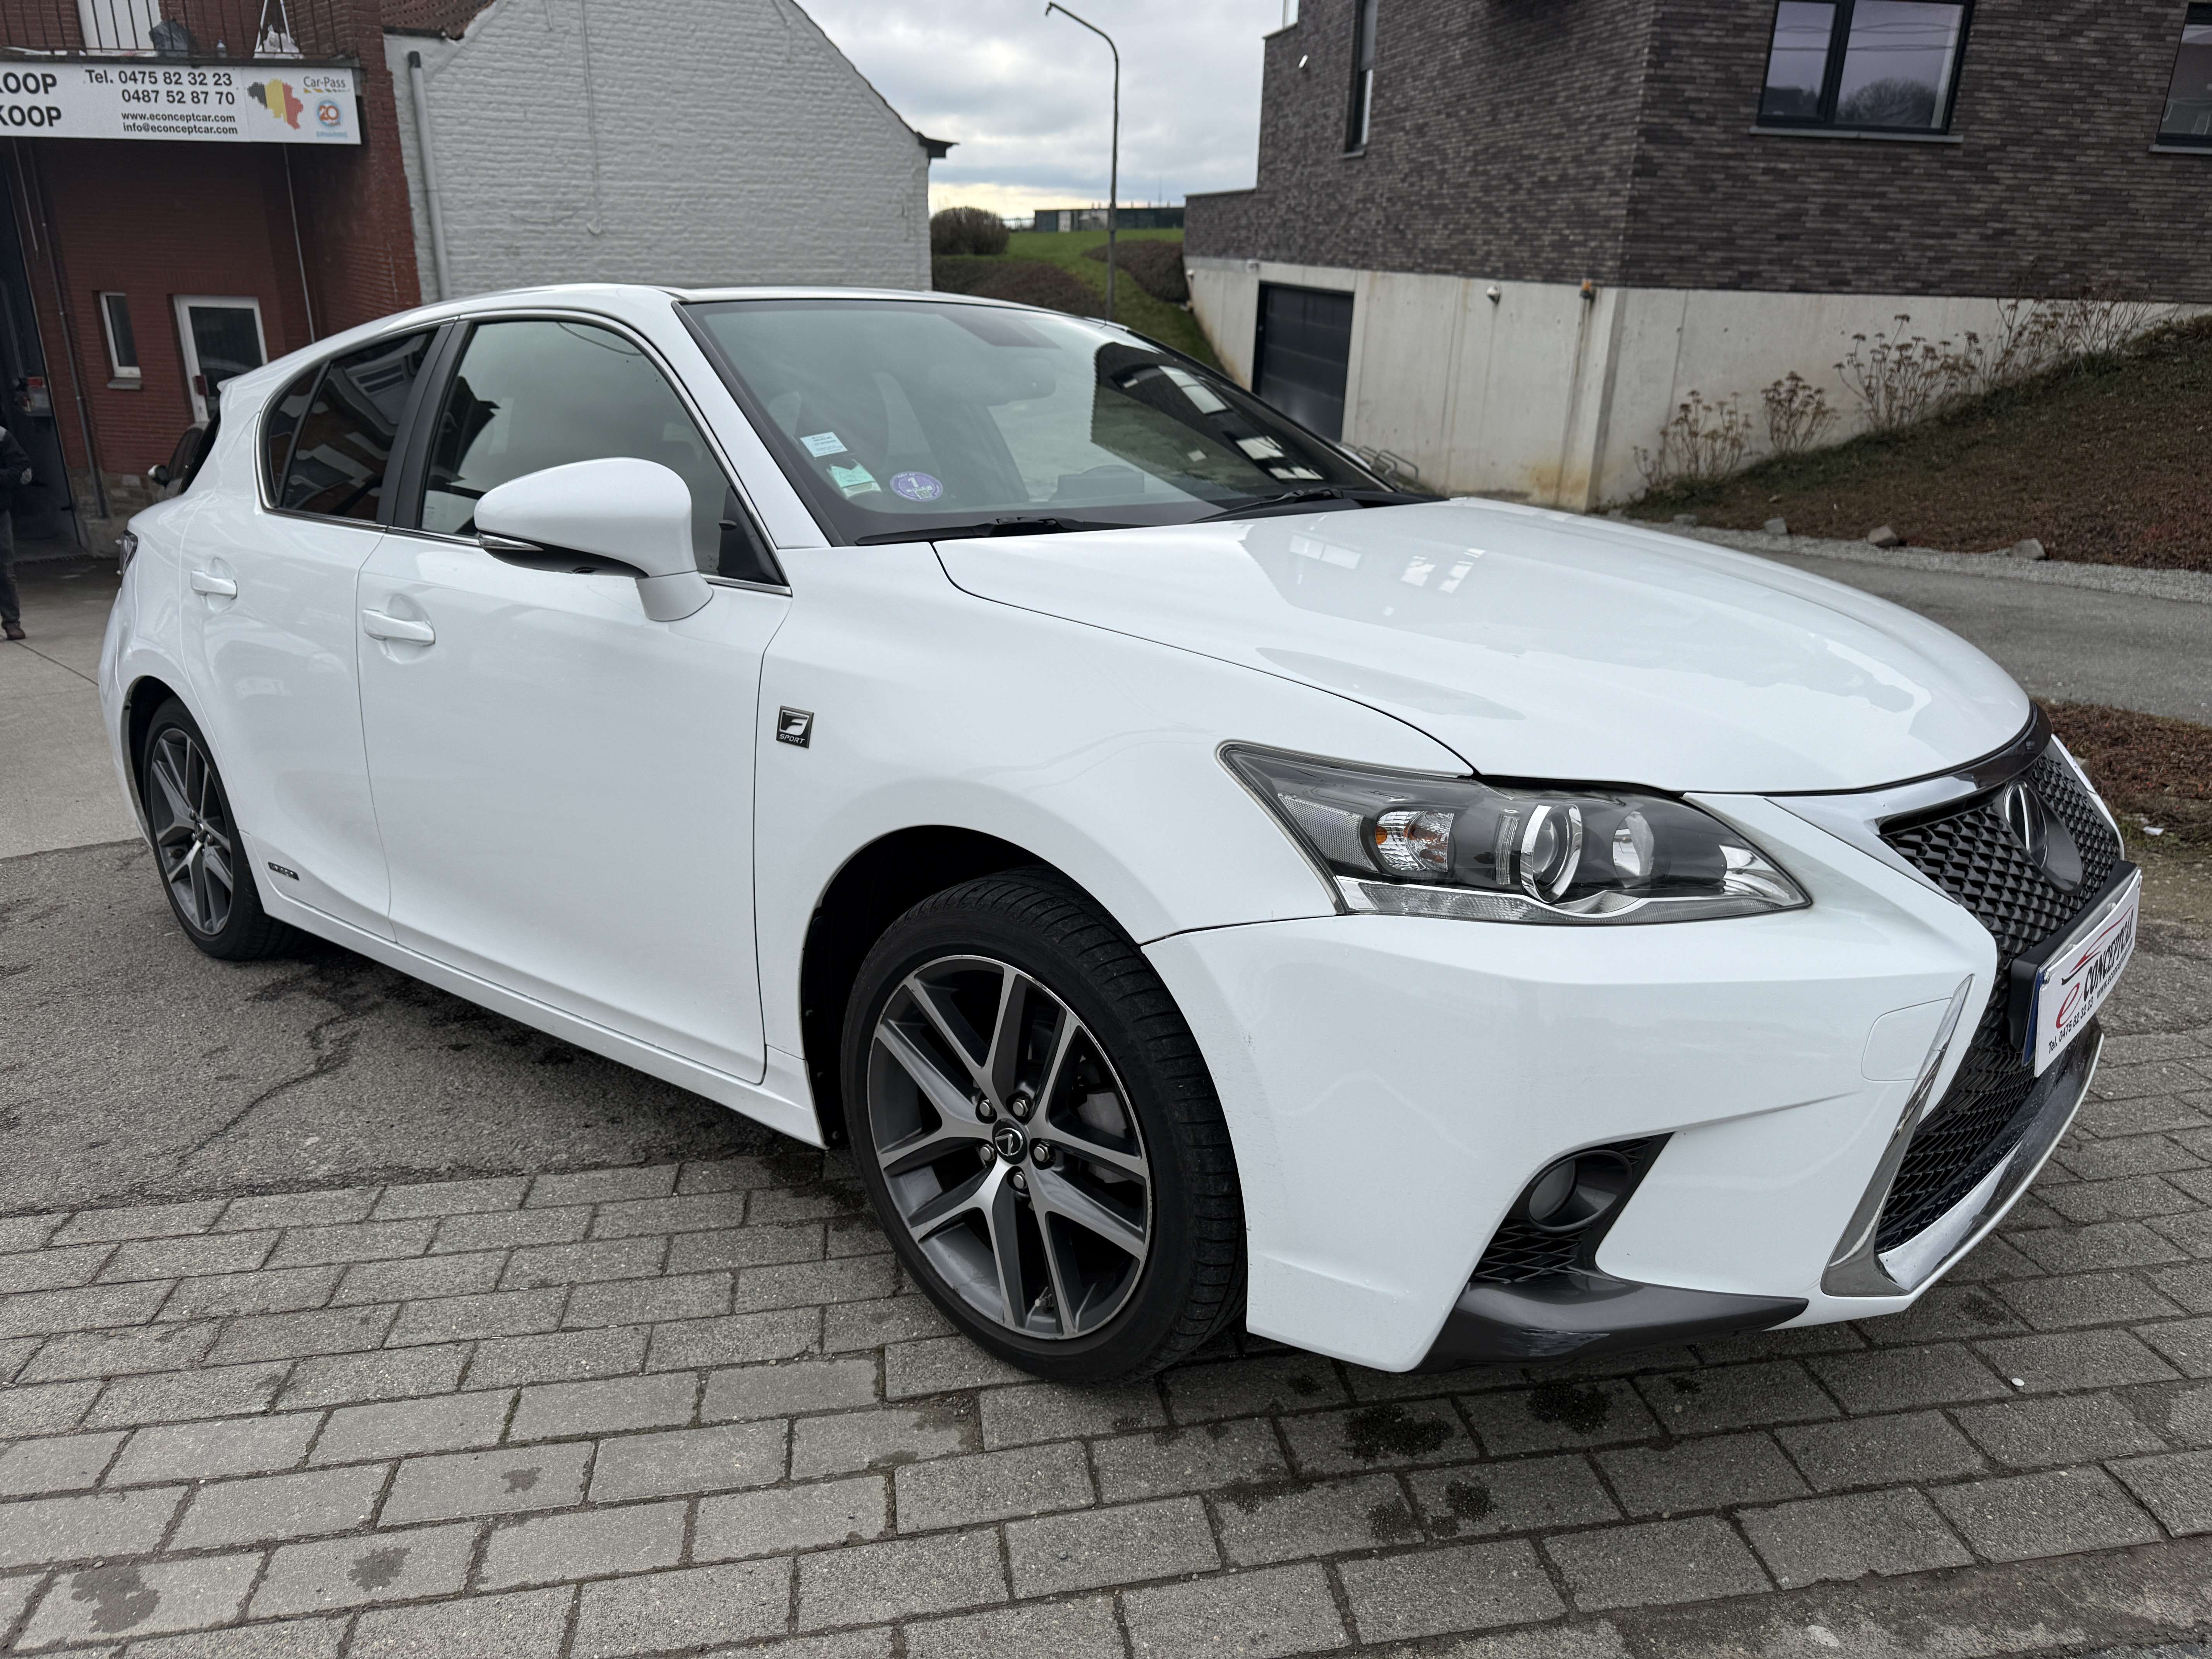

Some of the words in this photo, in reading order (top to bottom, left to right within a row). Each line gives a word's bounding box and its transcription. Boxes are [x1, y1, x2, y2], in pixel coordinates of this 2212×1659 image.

[0, 72, 57, 94] OOP
[85, 69, 113, 84] Tel.
[118, 70, 158, 84] 0475
[163, 71, 183, 85] 82
[188, 72, 208, 86] 32
[213, 72, 233, 86] 23
[303, 76, 346, 88] Car-Pass
[121, 89, 160, 103] 0487
[166, 90, 186, 104] 52
[191, 91, 209, 105] 87
[215, 91, 235, 105] 70
[121, 112, 235, 123] www.econceptcar.com
[319, 105, 339, 121] 20
[123, 122, 238, 135] info@econceptcar.com
[780, 711, 808, 732] F
[779, 733, 805, 744] SPORT
[2049, 1036, 2057, 1054] Tel.
[2059, 1019, 2072, 1042] 0475
[2073, 1012, 2080, 1027] 82
[2080, 1003, 2087, 1019] 32
[2087, 996, 2094, 1012] 23
